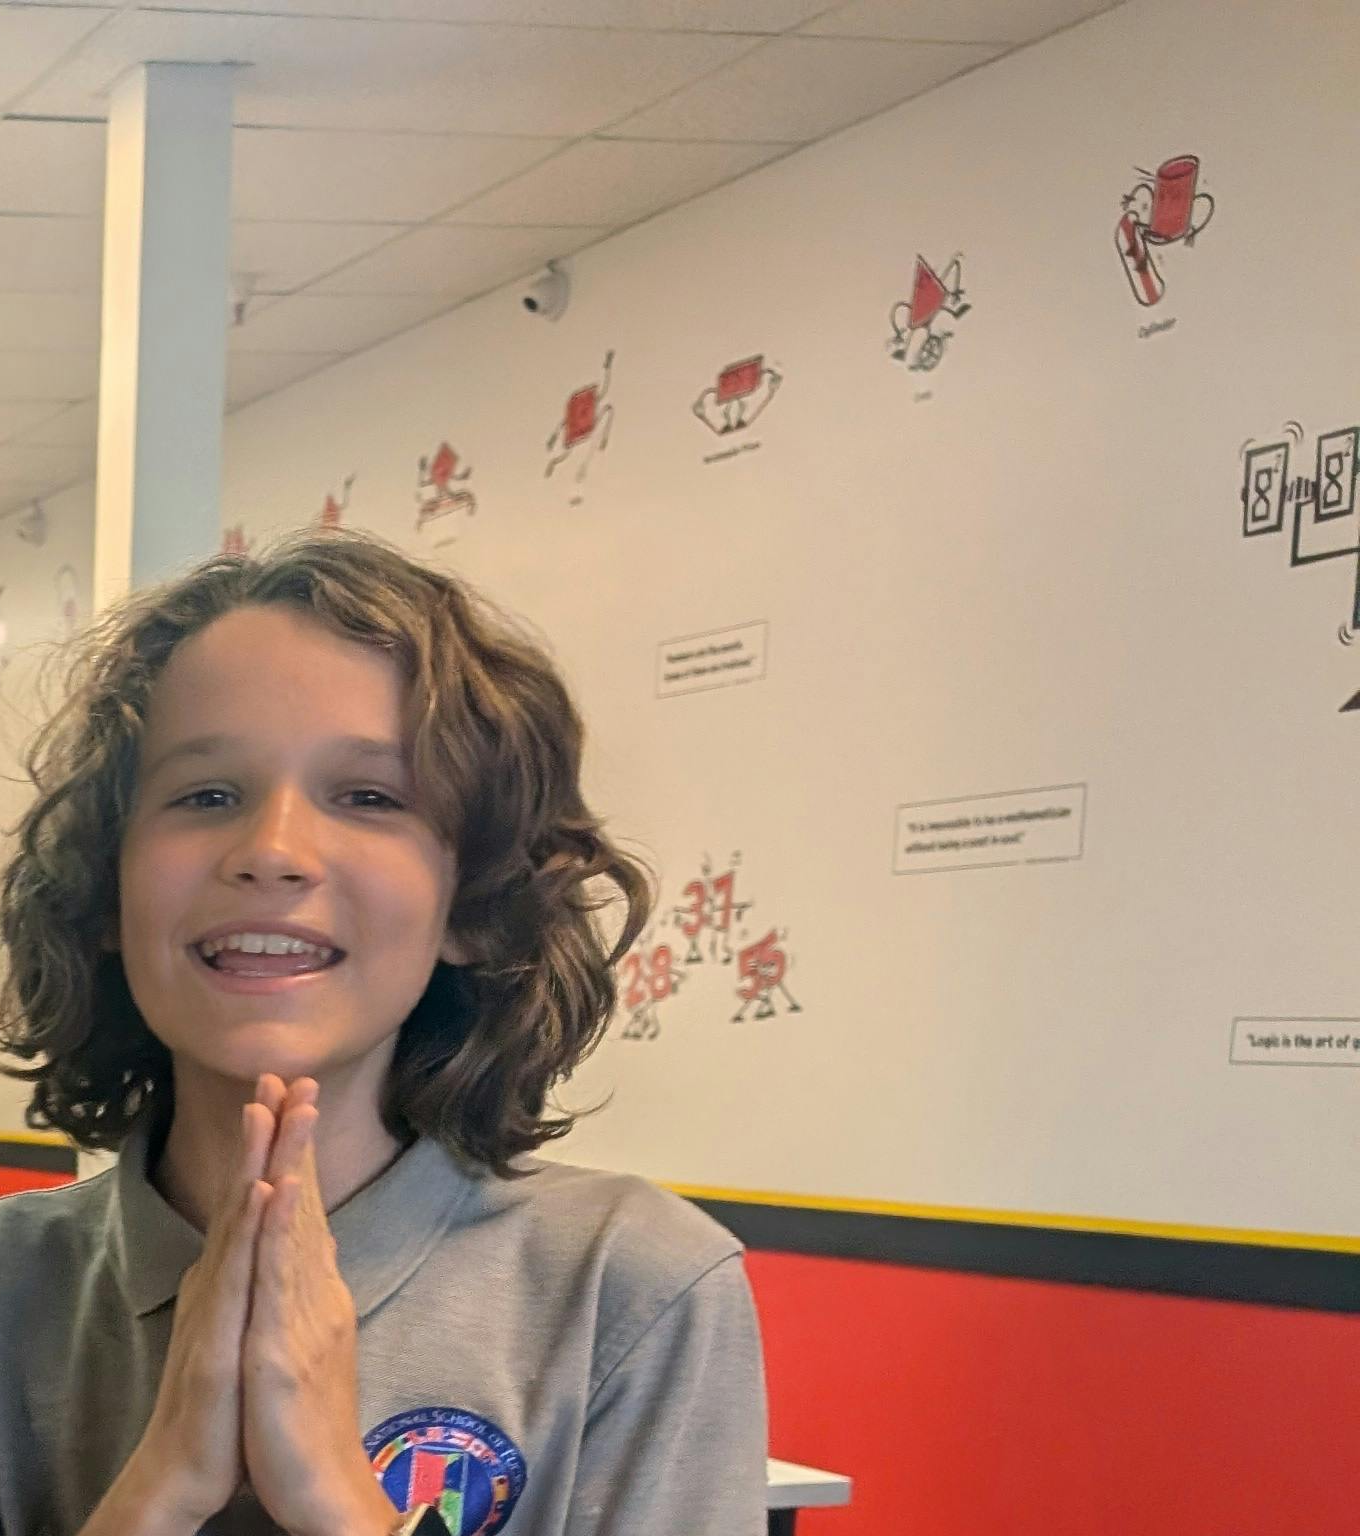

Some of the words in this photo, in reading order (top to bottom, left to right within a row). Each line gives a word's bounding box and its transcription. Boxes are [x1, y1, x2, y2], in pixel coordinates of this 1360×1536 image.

[1294, 1033, 1313, 1048] the
[1315, 1034, 1333, 1048] art
[1335, 1034, 1351, 1048] of
[432, 1409, 488, 1440] SCHOOL
[486, 1433, 503, 1450] OF
